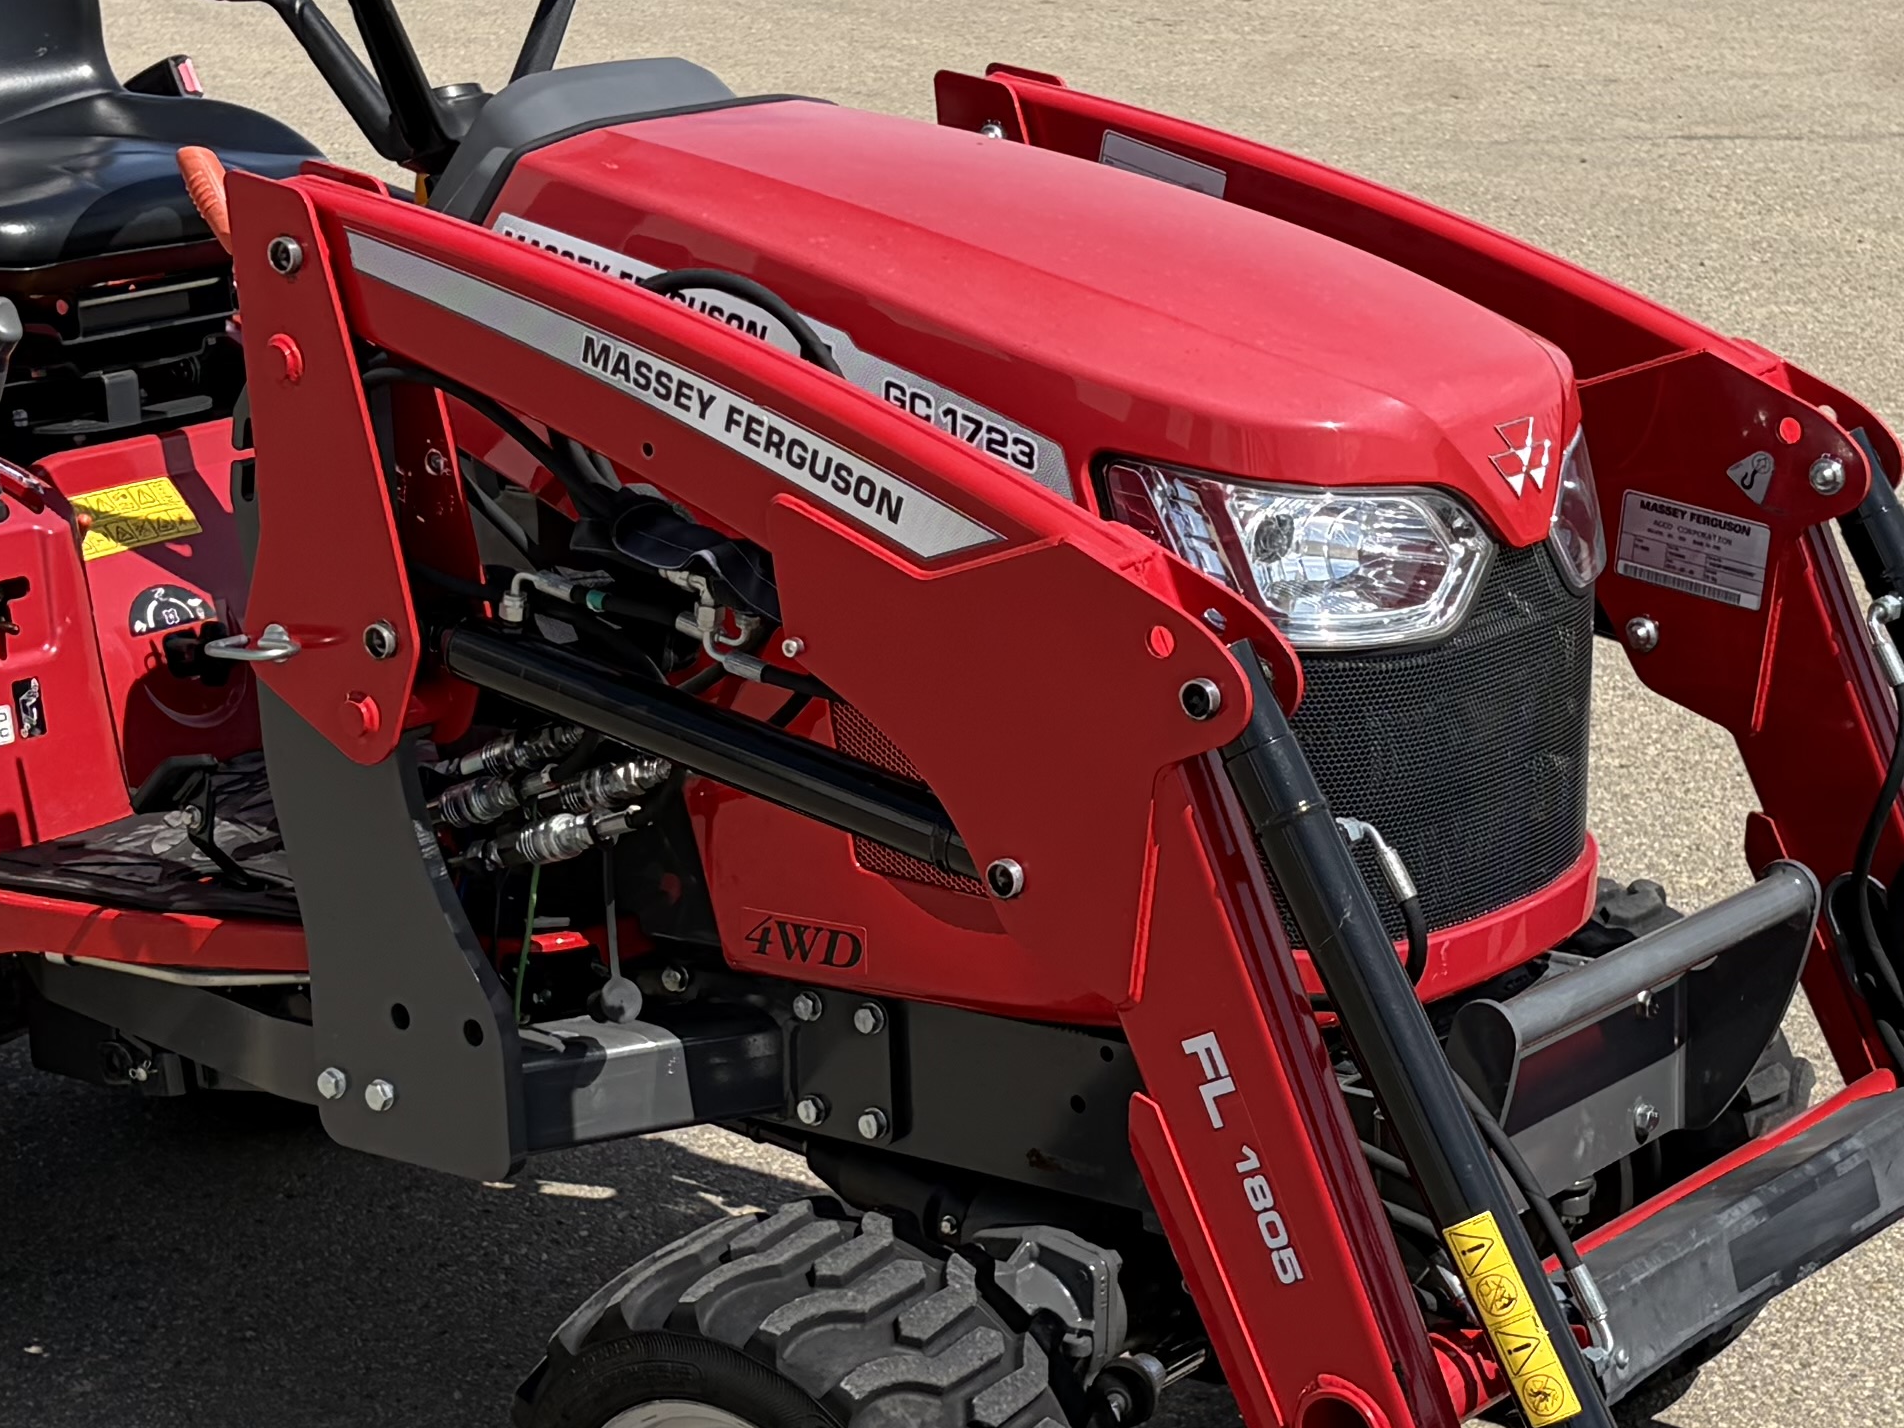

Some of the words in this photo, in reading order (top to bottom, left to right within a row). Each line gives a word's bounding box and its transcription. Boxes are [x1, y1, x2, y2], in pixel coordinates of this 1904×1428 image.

[581, 335, 717, 420] MASSEY
[724, 404, 904, 525] FERGUSON
[884, 379, 932, 423] GC
[941, 406, 1035, 470] 1723
[1639, 499, 1687, 521] MASSEY
[1689, 512, 1752, 537] FERGUSON
[744, 915, 864, 969] 4WD
[1181, 1031, 1237, 1130] FL
[1235, 1144, 1305, 1285] 1805
